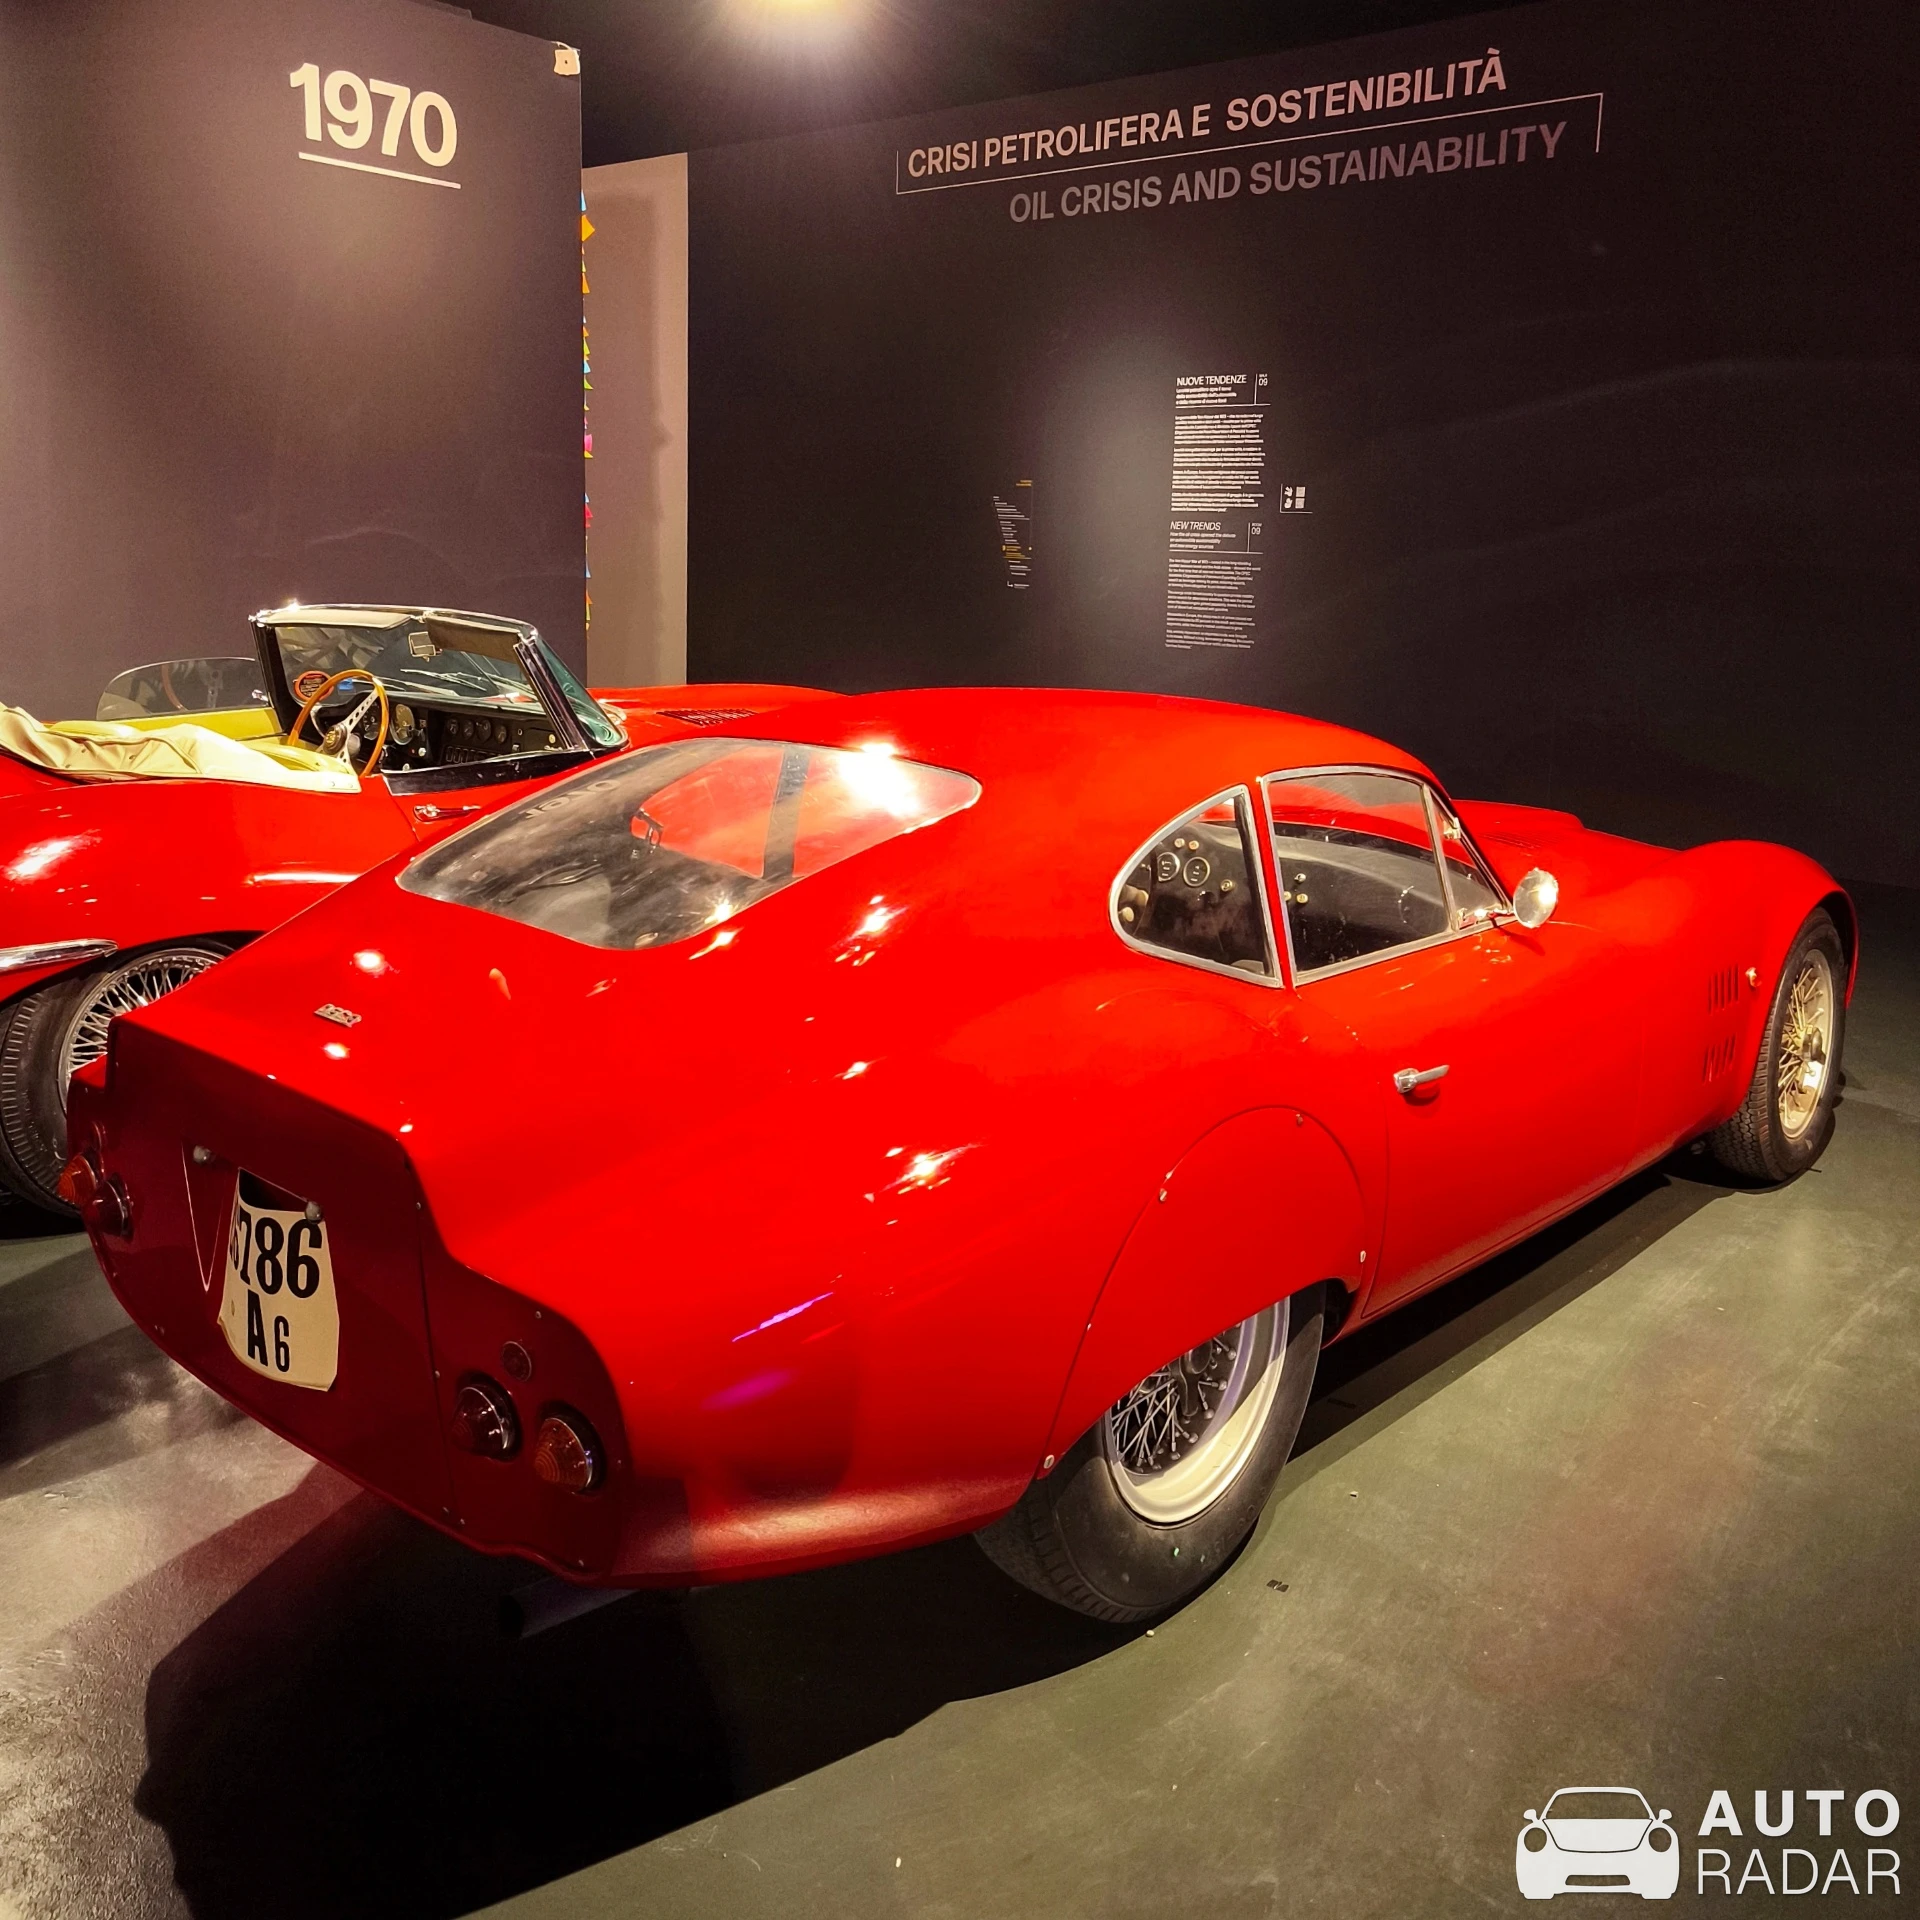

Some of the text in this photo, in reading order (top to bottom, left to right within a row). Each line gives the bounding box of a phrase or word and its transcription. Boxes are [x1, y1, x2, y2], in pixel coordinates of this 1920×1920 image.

[290, 62, 458, 167] 1970
[908, 47, 1507, 178] CRISI PETROLIFERA E SOSTENIBILITÀ
[1009, 121, 1567, 223] OIL CRISIS AND SUSTAINABILITY
[1176, 376, 1205, 386] NUOVE
[1205, 374, 1248, 385] TENDENZE
[1170, 520, 1222, 531] NEW TRENDS
